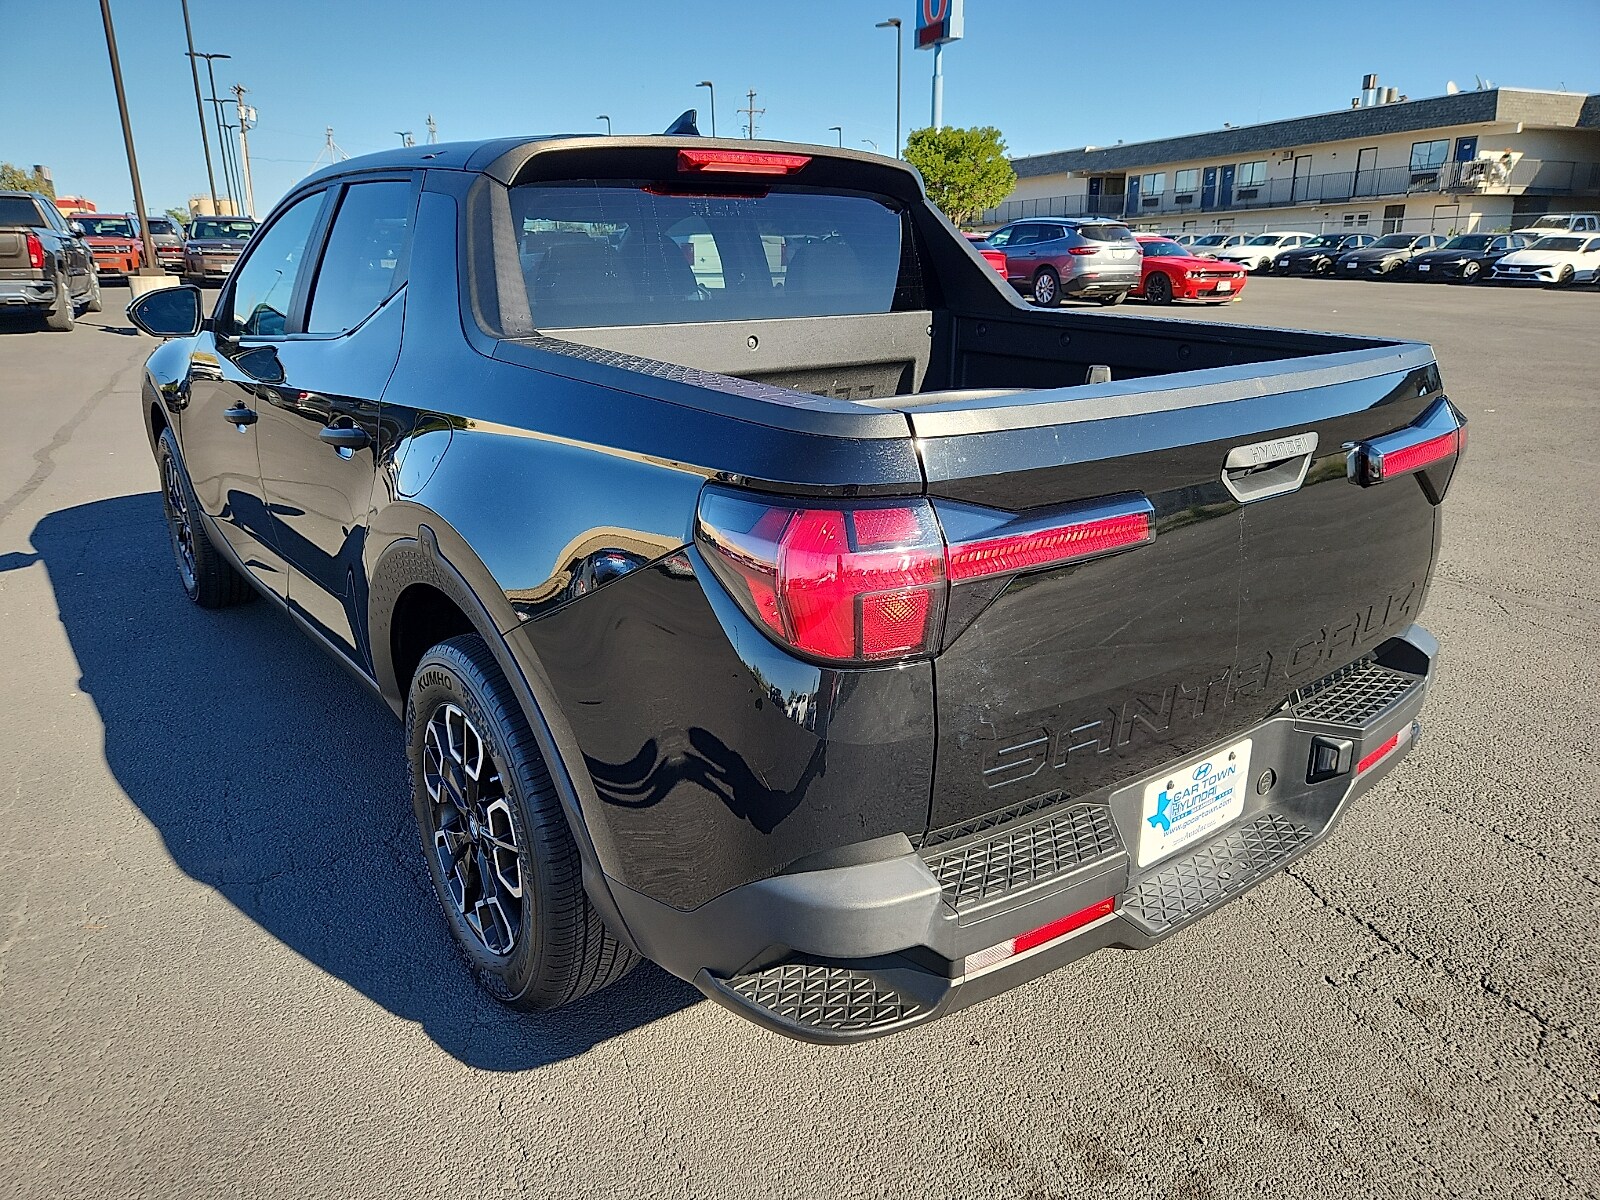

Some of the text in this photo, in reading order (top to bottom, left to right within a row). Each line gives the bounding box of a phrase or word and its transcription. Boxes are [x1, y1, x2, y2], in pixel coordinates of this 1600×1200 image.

[1249, 437, 1309, 463] HYUNDAI
[417, 670, 453, 692] KUMHO
[982, 580, 1417, 789] SANTA CRUZ
[1173, 763, 1237, 803] CAR TOWN
[1171, 785, 1218, 816] HYUNDAI
